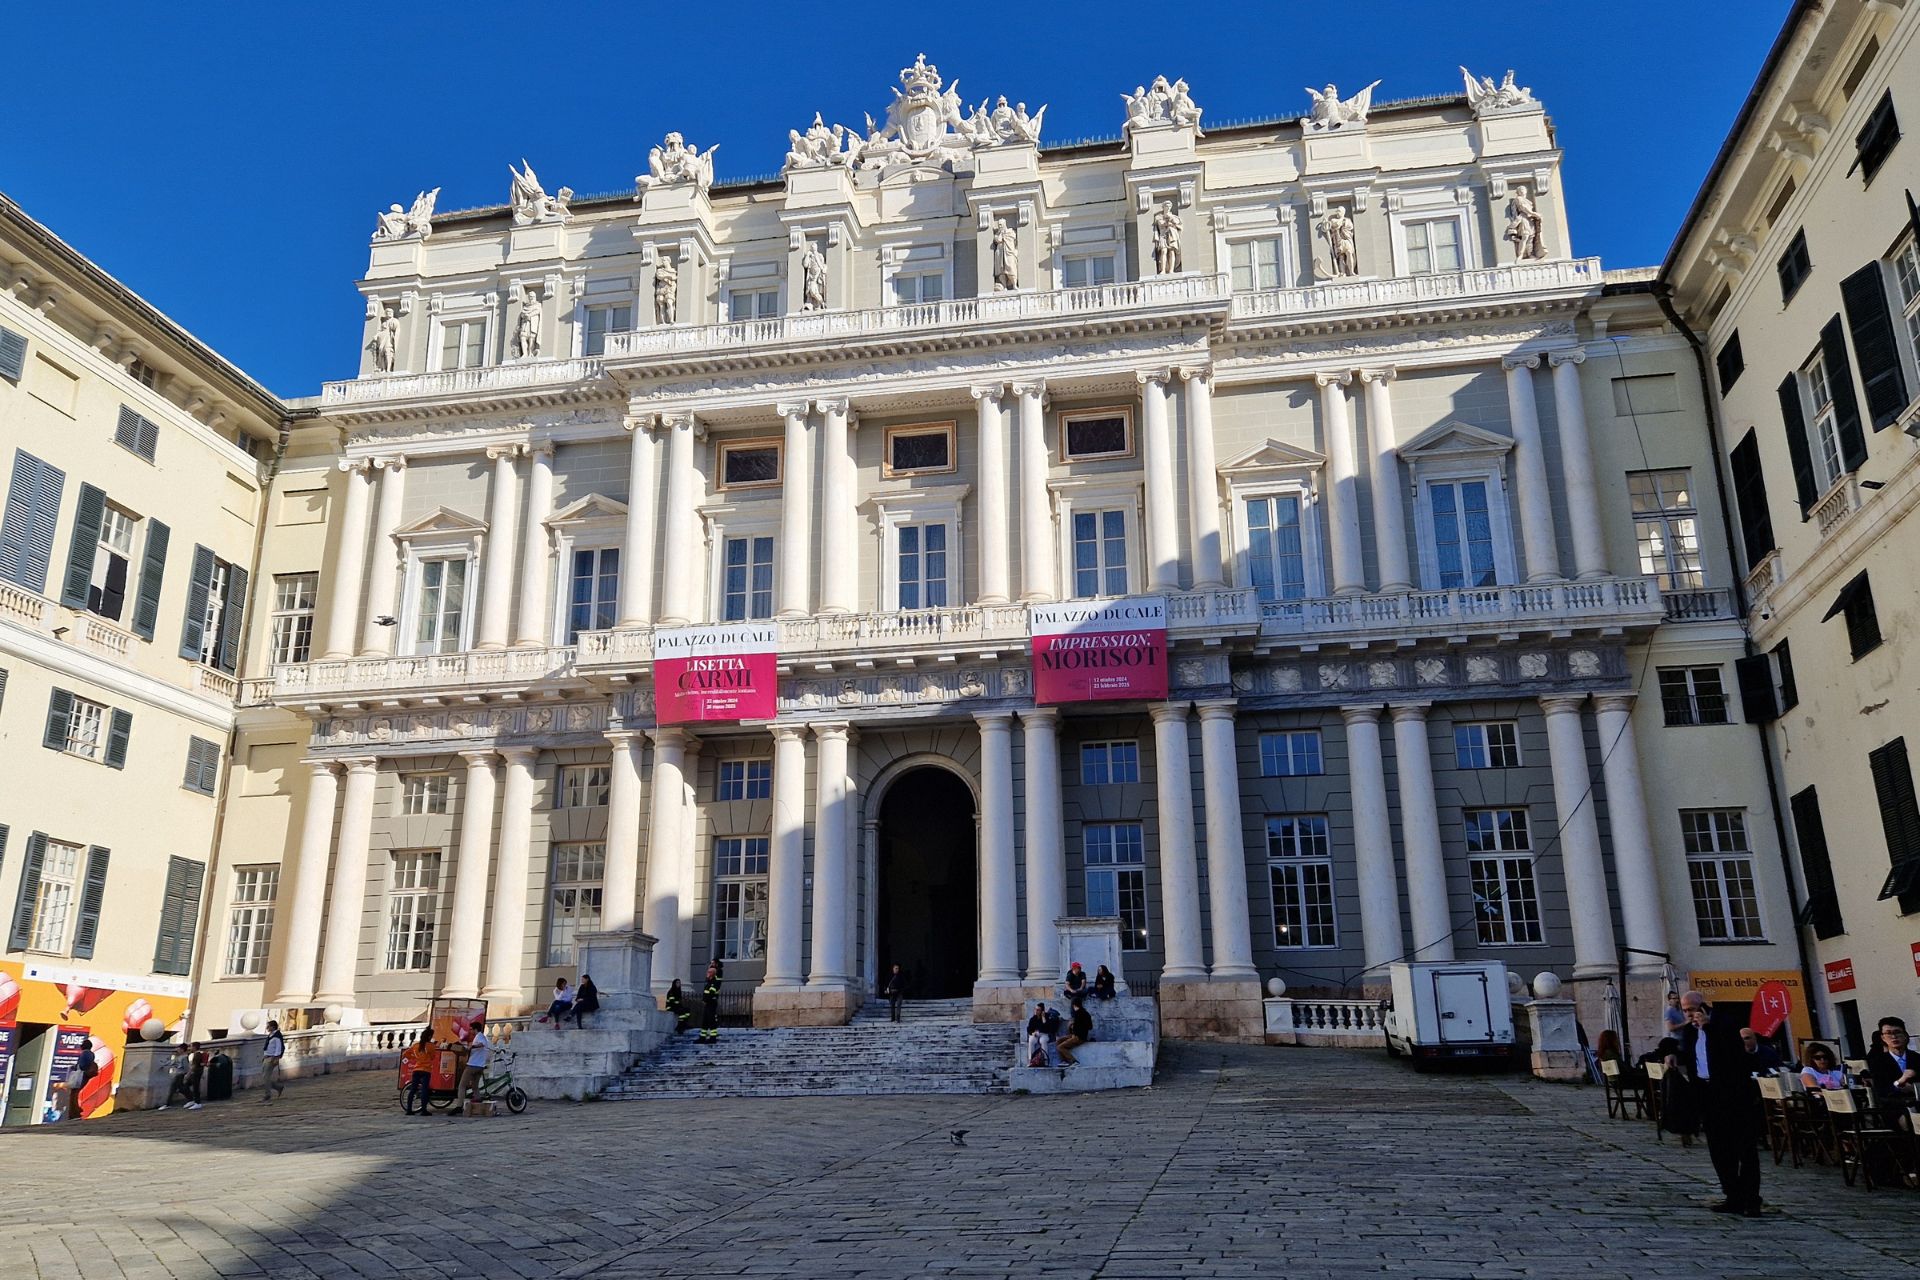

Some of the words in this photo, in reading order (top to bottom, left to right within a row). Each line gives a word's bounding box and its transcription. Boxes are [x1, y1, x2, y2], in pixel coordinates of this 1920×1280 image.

[1035, 610, 1098, 623] PALAZZO
[1104, 606, 1163, 619] DUCALE
[658, 634, 716, 648] PALAZZO
[721, 631, 775, 644] DUCALE
[686, 658, 745, 672] LISETTA
[1042, 647, 1160, 671] MORISOT
[678, 670, 751, 690] CARMI
[1694, 978, 1732, 988] Festival
[1735, 978, 1758, 987] della
[61, 1034, 85, 1046] RAISE
